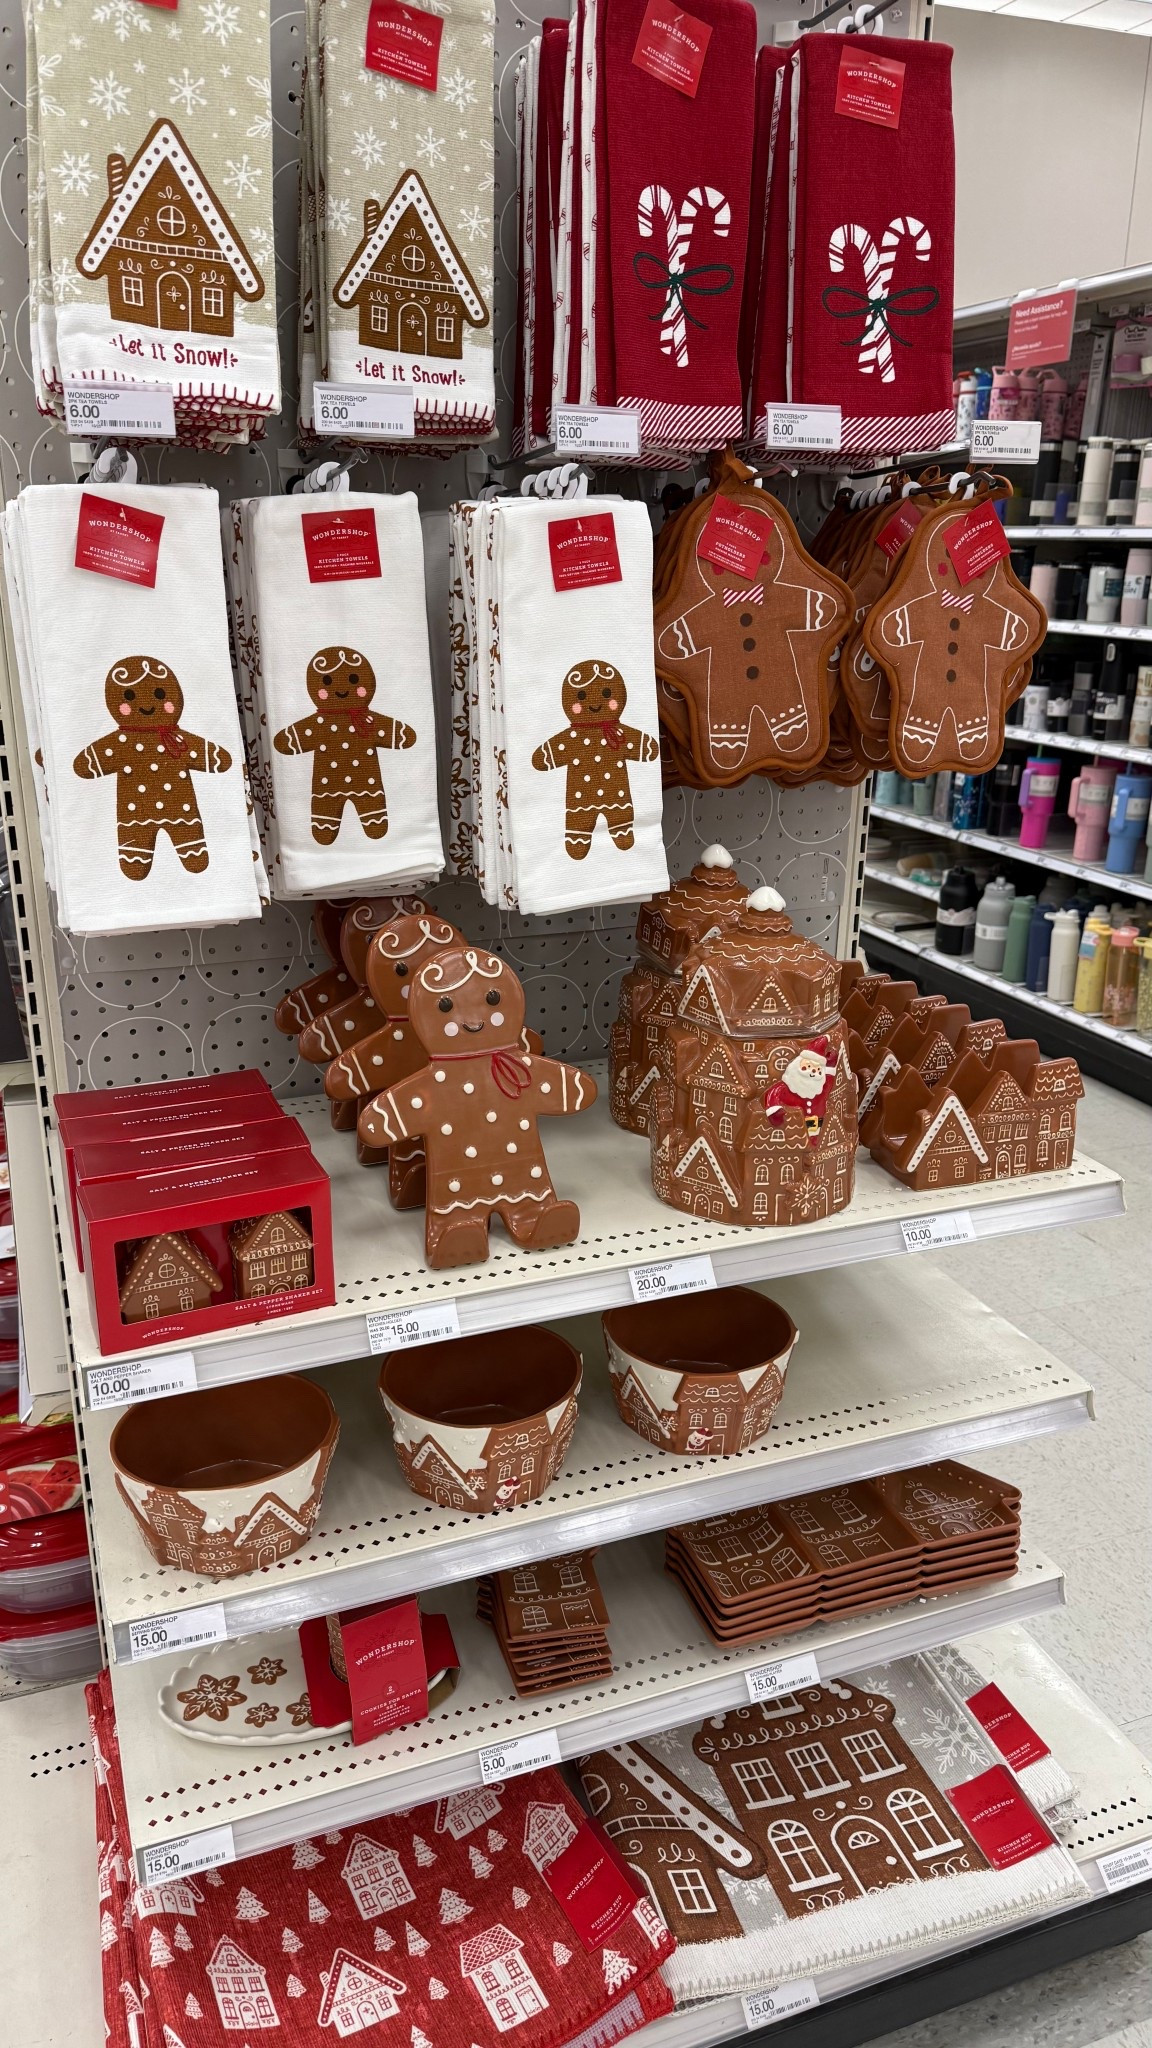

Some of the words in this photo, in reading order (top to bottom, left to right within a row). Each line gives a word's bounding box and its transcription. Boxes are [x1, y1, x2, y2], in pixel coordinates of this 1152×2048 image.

[377, 21, 433, 46] WONDERSHOP
[651, 19, 700, 53] WONDERSHOP
[378, 48, 403, 61] KITCHEN
[405, 58, 427, 70] TOWELS
[647, 46, 670, 63] KITCHEN
[670, 61, 690, 75] TOWELS
[847, 70, 896, 88] WONDERSHOP
[847, 94, 870, 103] KITCHEN
[871, 100, 891, 110] TOWELS
[1015, 307, 1031, 318] Need
[1030, 299, 1064, 314] Assistance?
[118, 333, 145, 356] Let
[151, 343, 166, 361] it
[173, 342, 228, 369] Snow!
[364, 357, 386, 379] Let
[392, 365, 406, 381] it
[411, 364, 457, 386] Snow!
[68, 391, 120, 400] WONDERSHOP
[320, 394, 368, 403] WONDERSHOP
[70, 404, 100, 418] 6.00
[321, 406, 349, 419] 6.00
[558, 415, 599, 423] WONDERSHOP
[559, 426, 582, 439] 6.00
[773, 423, 793, 435] 6.00
[975, 435, 993, 446] 6.00
[89, 520, 151, 543] WONDERSHOP
[312, 528, 368, 541] WONDERSHOP
[715, 517, 760, 542] WONDERSHOP
[953, 520, 993, 550] WONDERSHOP
[557, 535, 609, 550] WONDERSHOP
[89, 546, 118, 558] KITCHEN
[119, 554, 145, 566] TOWELS
[562, 565, 586, 573] KITCHEN
[587, 561, 609, 569] TOWELS
[902, 1218, 936, 1228] WONDERSHOP
[905, 1228, 932, 1242] 10.00
[634, 1263, 673, 1276] WONDERSHOP
[637, 1276, 666, 1291] 20.00
[258, 1297, 284, 1306] PEPPER
[284, 1292, 311, 1300] SHAKER
[368, 1310, 413, 1324] WONDERSHOP
[142, 1326, 184, 1339] WONDERSHOP
[370, 1332, 384, 1340] NOW
[391, 1321, 419, 1336] 15.00
[89, 1363, 142, 1379] WONDERSHOP
[113, 1372, 132, 1380] PEPPER
[133, 1368, 152, 1376] SHAKER
[93, 1378, 130, 1397] 10.00
[131, 1616, 178, 1632] WONDERSHOP
[133, 1629, 168, 1648] 15.00
[355, 1639, 415, 1667] WONDERSHOP
[750, 1664, 782, 1678] WONDERSHOP
[753, 1676, 777, 1691] 15.00
[360, 1702, 387, 1716] COOKIES
[388, 1697, 401, 1705] FOR
[401, 1688, 422, 1700] SANTA
[984, 1712, 1012, 1730] DERSHOP
[481, 1741, 519, 1757] WONDERSHOP
[1004, 1749, 1020, 1760] CHEN
[1020, 1742, 1031, 1750] RUG
[483, 1756, 505, 1772] 5.00
[971, 1798, 1015, 1823] WONDERSHOP
[145, 1839, 189, 1858] WONDERSHOP
[997, 1839, 1021, 1853] KITCHEN
[1020, 1832, 1032, 1841] RUG
[148, 1854, 180, 1873] 15.00
[566, 1858, 604, 1900] WONDERSHOP
[591, 1906, 613, 1929] KITCHEN
[613, 1894, 622, 1908] RUG
[745, 1985, 779, 2002] WONDERSHOP
[749, 1999, 774, 2017] 15.00
